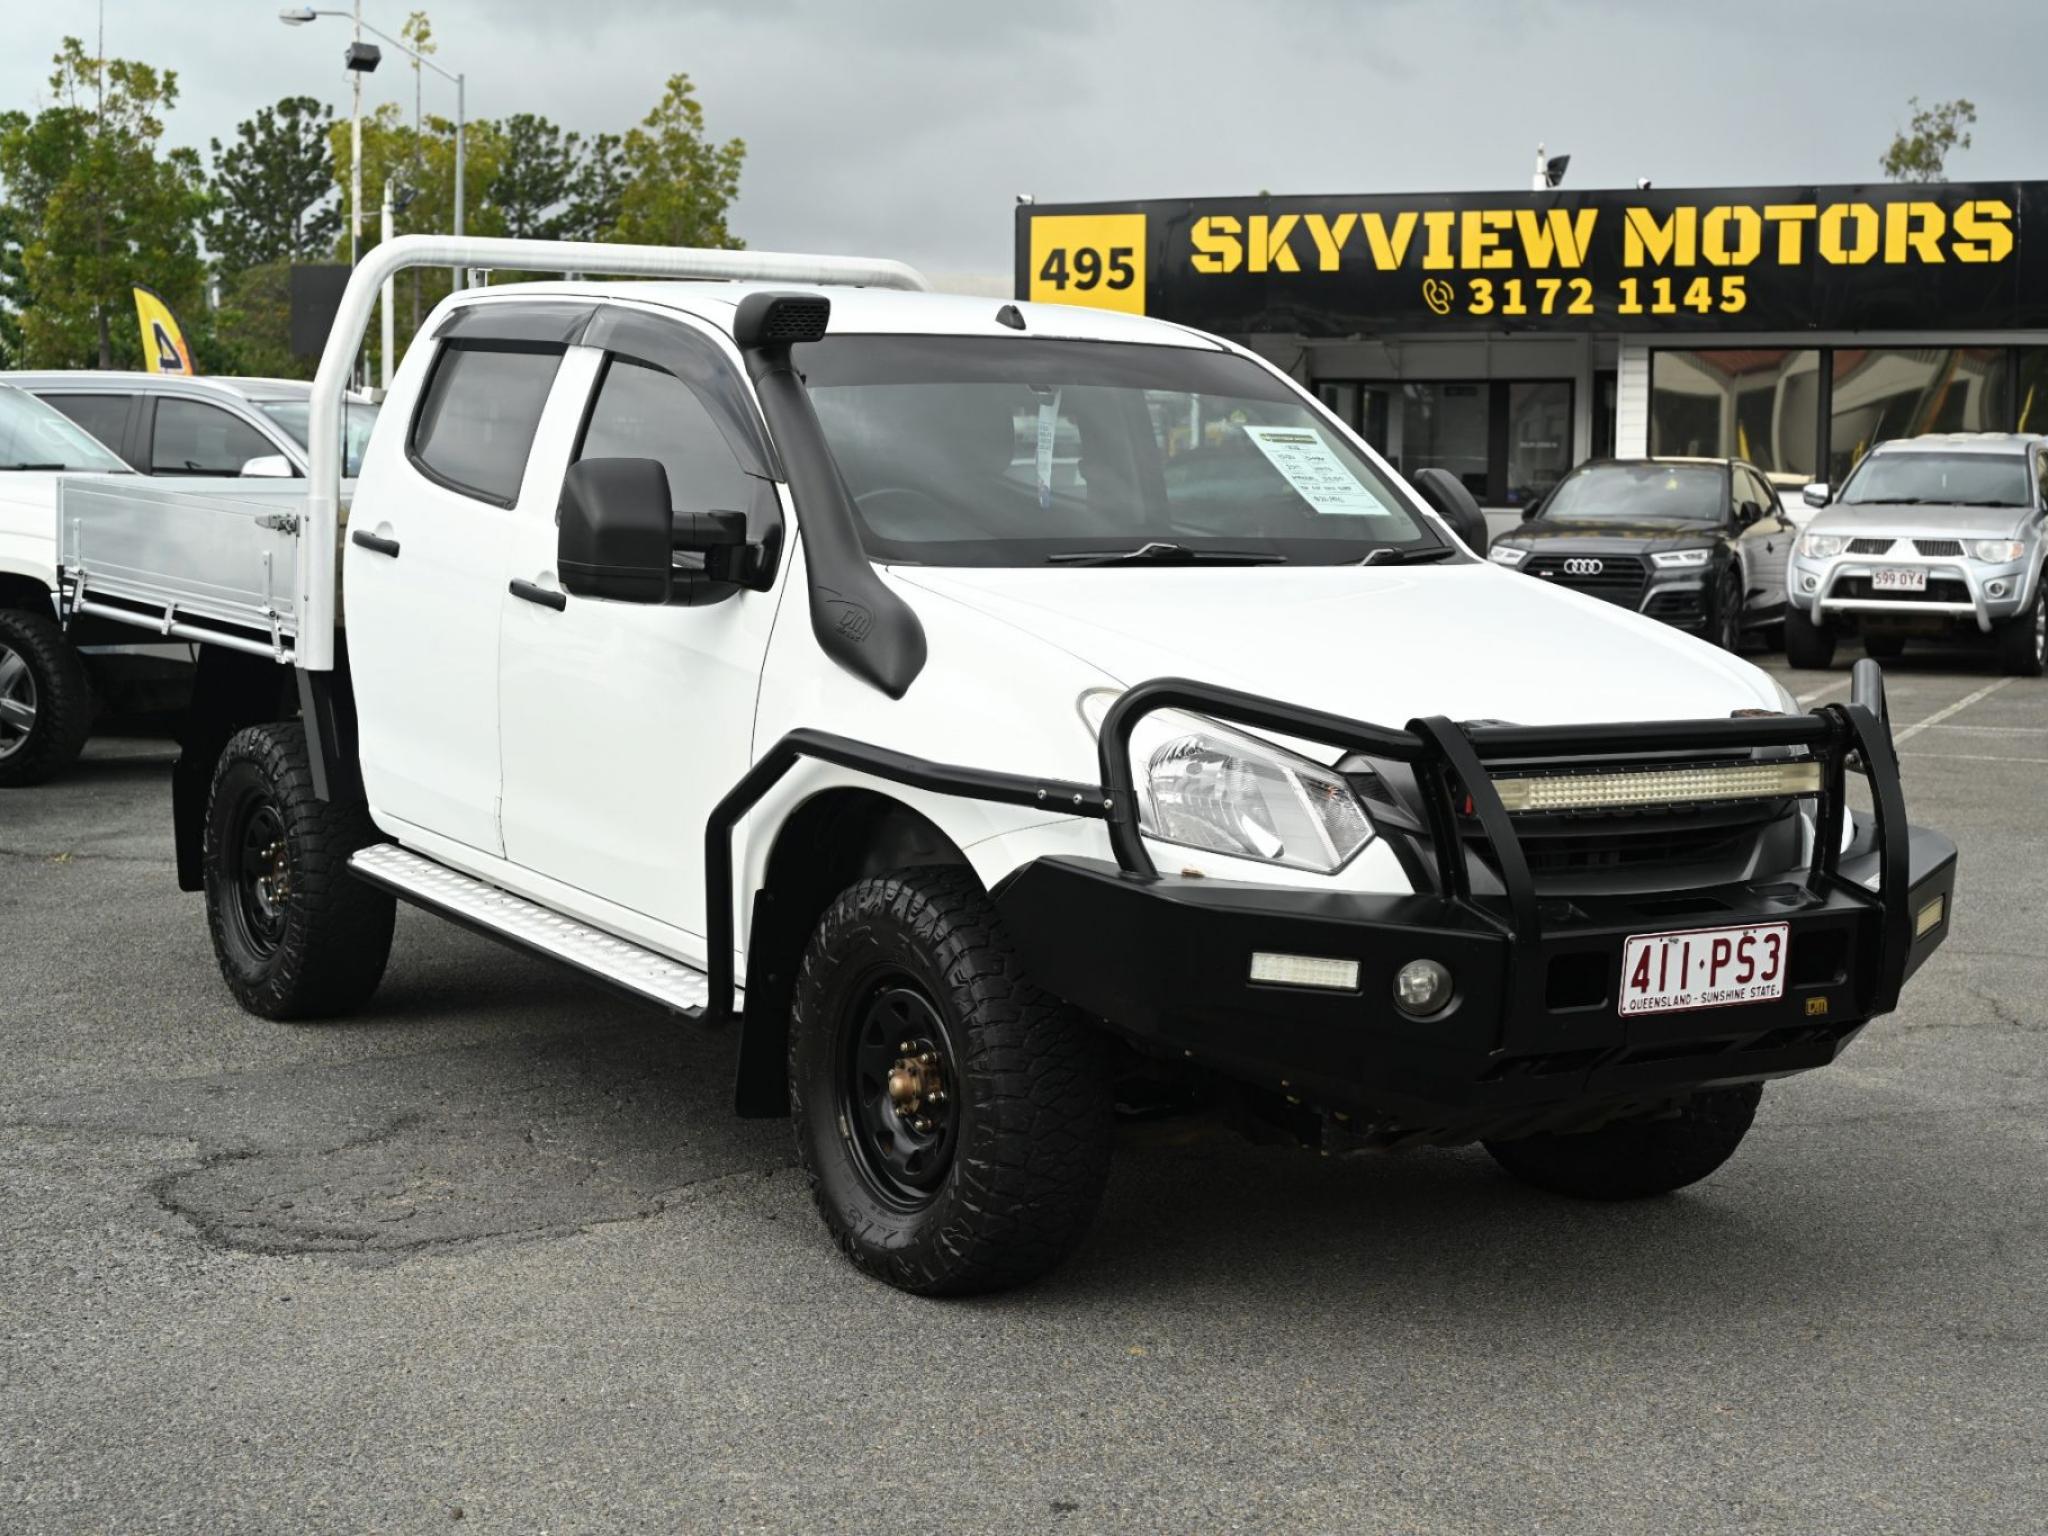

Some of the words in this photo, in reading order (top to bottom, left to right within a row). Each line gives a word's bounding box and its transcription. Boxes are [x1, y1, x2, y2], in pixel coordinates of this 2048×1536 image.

[1190, 208, 1599, 273] SKYVIEW
[1623, 200, 2014, 267] MOTORS
[1039, 247, 1135, 291] 495
[1467, 277, 1594, 315] 3172
[1617, 275, 1747, 315] 1145
[1629, 993, 1692, 1011] QUEENSLAND
[1700, 988, 1746, 1004] SUNSHINE
[1749, 984, 1777, 998] STATE
